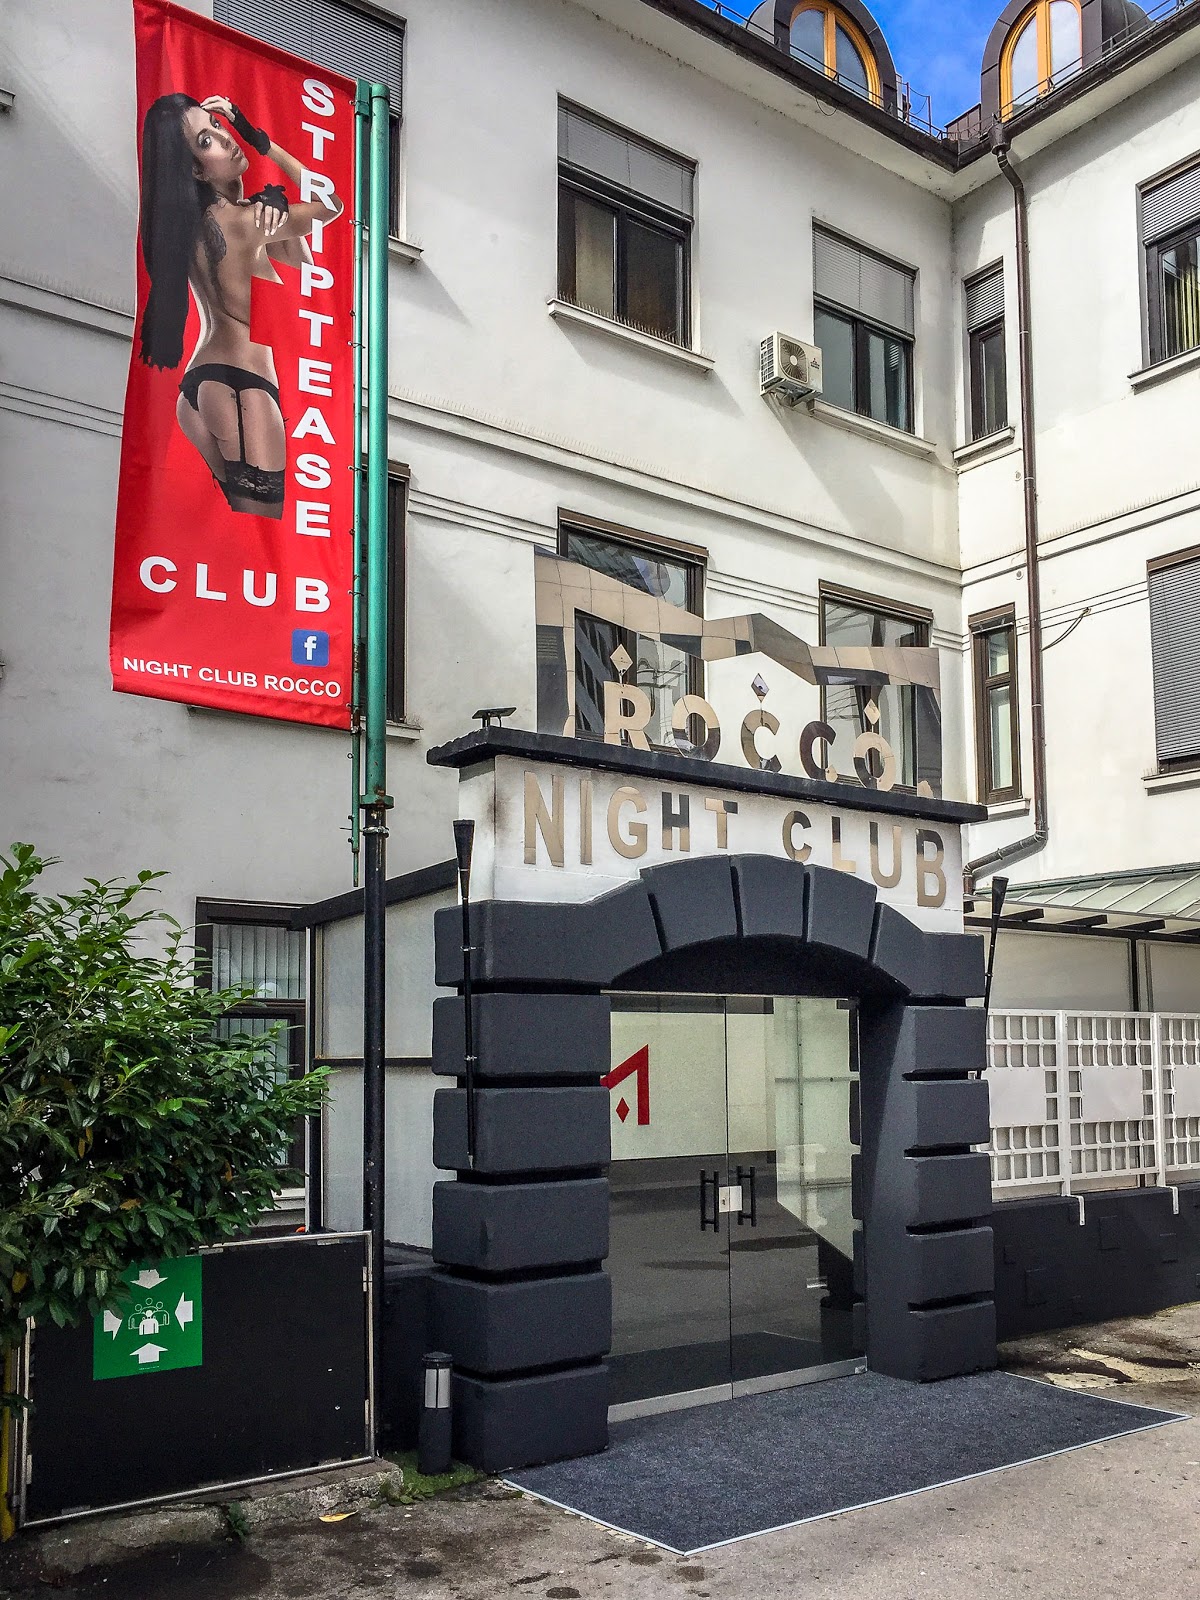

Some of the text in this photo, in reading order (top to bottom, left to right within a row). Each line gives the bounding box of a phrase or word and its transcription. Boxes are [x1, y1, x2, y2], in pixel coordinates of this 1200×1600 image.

[291, 78, 338, 538] STRIPTEASE
[139, 556, 331, 613] CLUB
[122, 656, 341, 698] NIGHT CLUB ROCCO
[304, 635, 317, 661] f
[603, 680, 896, 792] ROCCO
[523, 770, 947, 908] NIGHT CLUB
